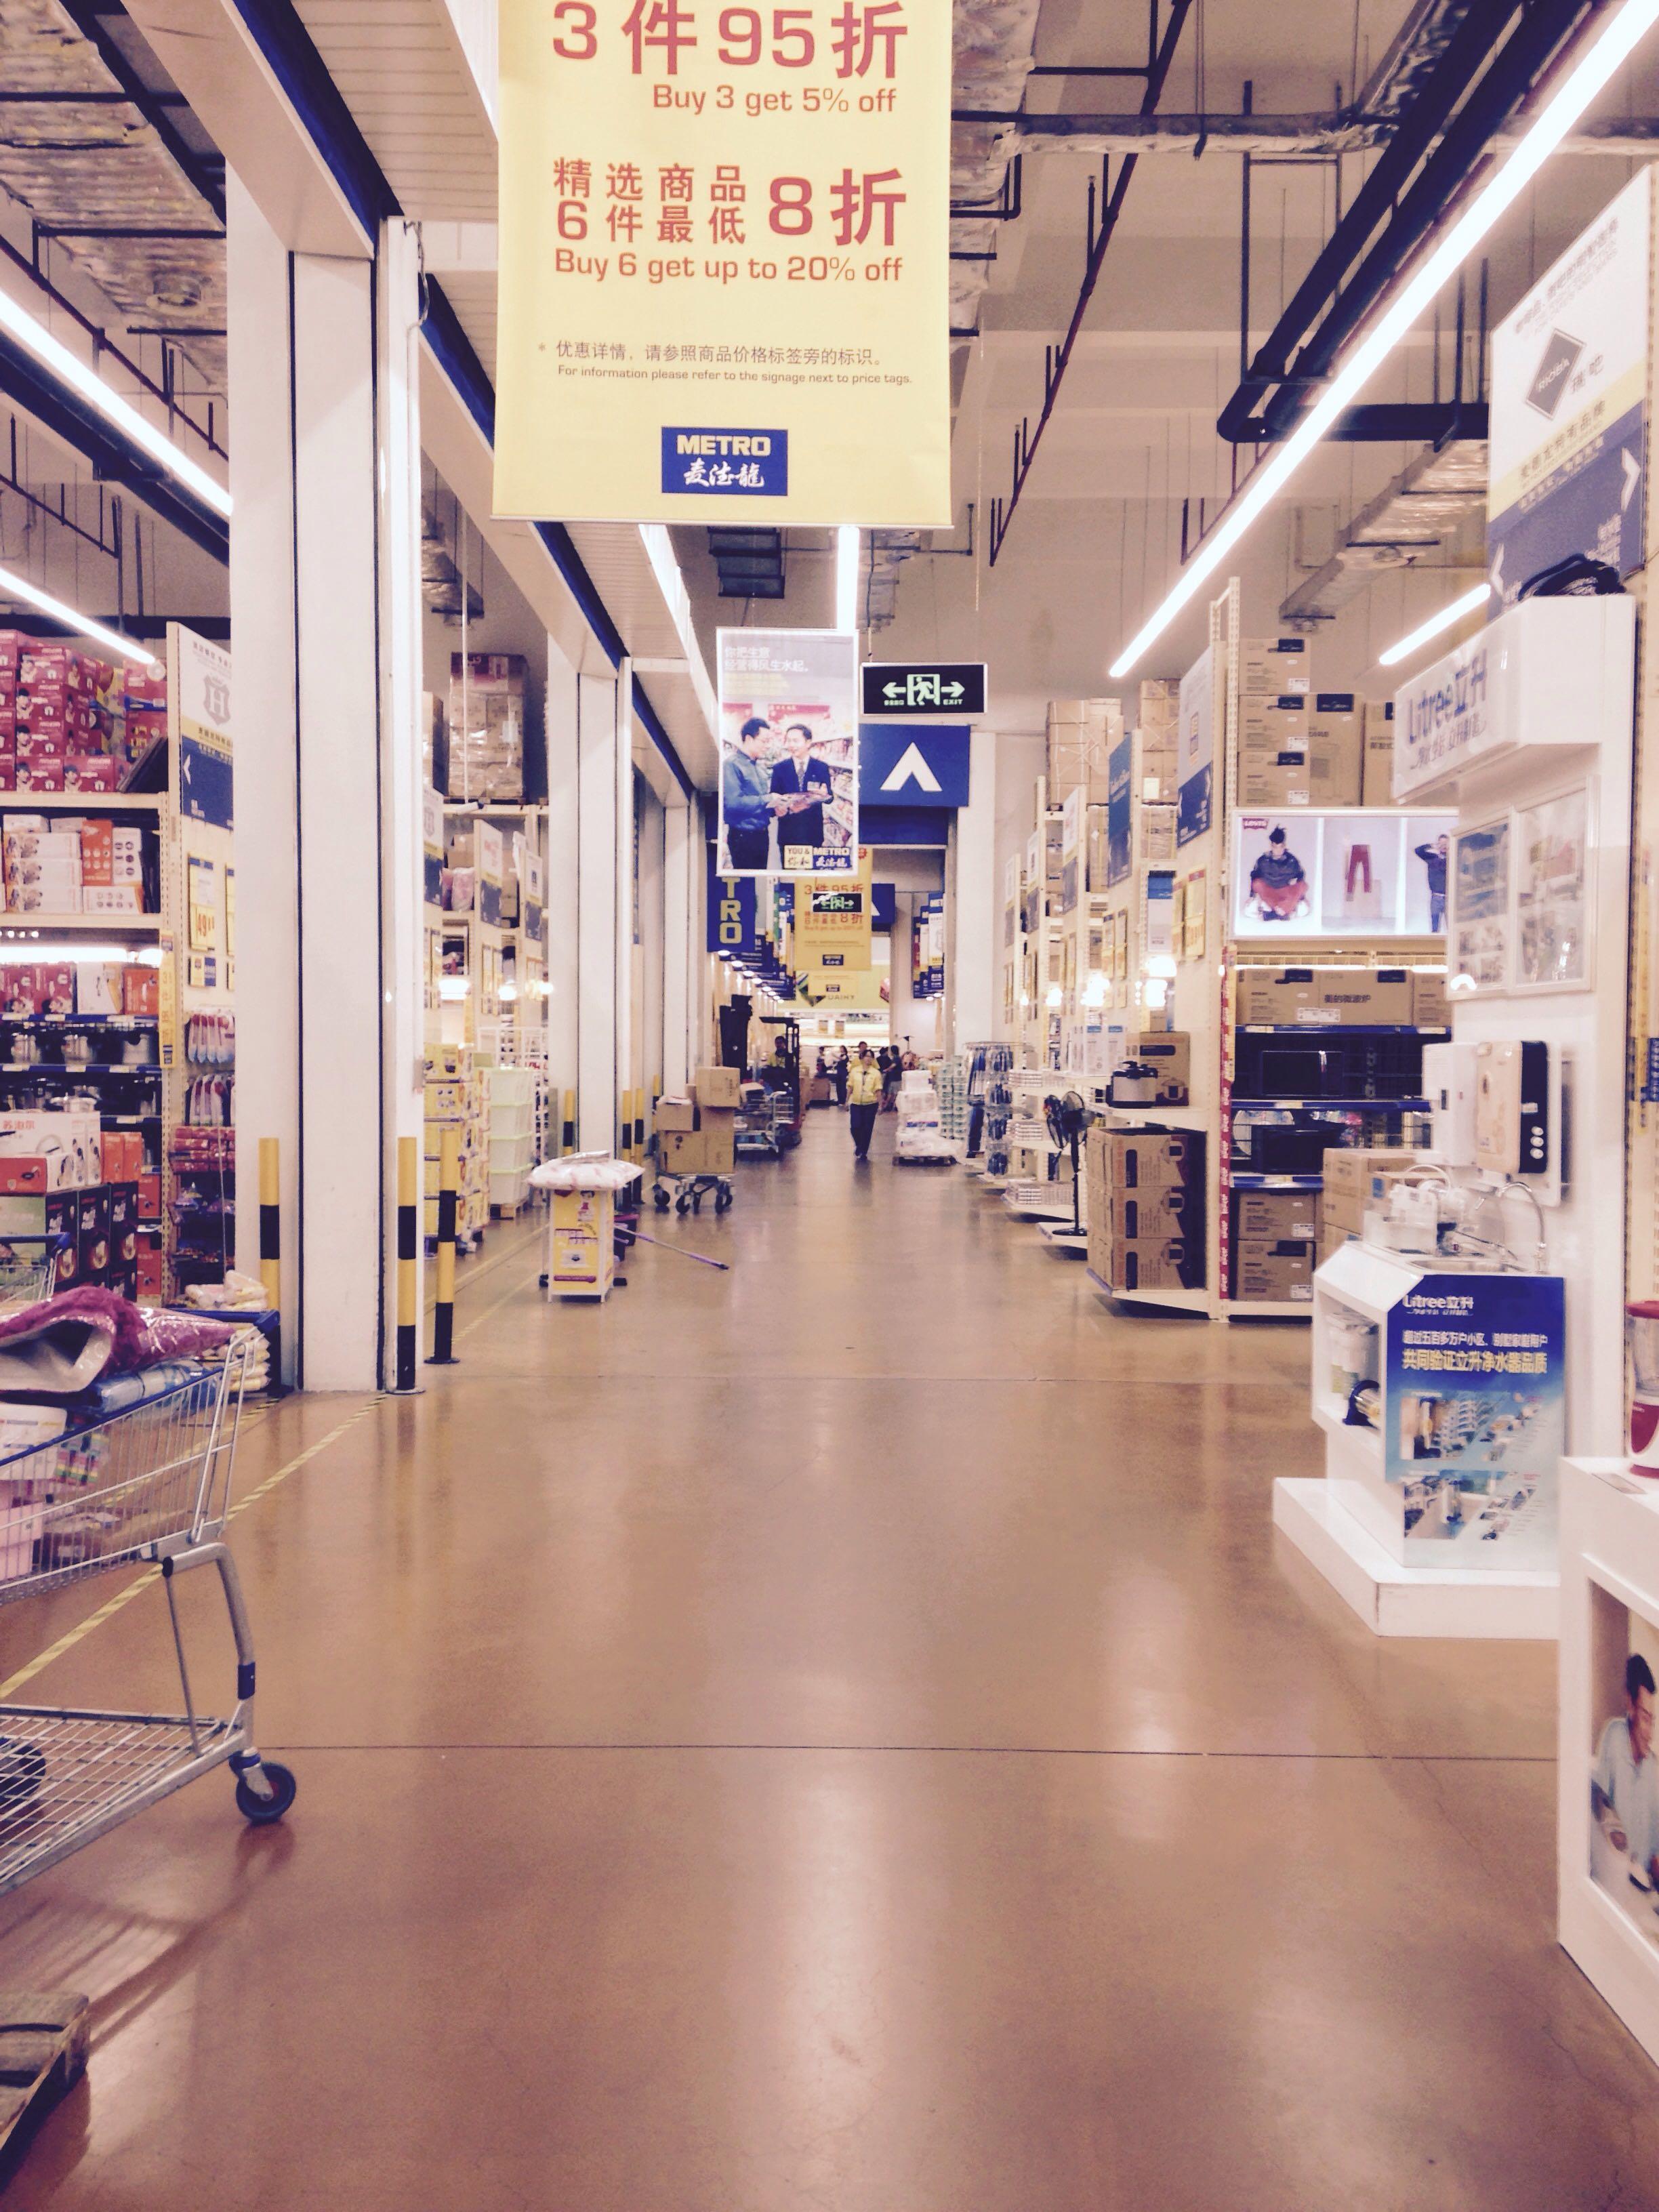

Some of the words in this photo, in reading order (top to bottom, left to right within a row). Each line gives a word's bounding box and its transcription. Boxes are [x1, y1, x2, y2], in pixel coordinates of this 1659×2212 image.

[653, 84, 705, 116] Buy
[716, 85, 734, 109] 3
[745, 89, 792, 117] get
[804, 87, 848, 112] 5%
[859, 89, 896, 112] off
[554, 157, 746, 202] 精选商品
[769, 169, 907, 246] 8折
[555, 248, 608, 282] Buy
[618, 252, 636, 276] 6
[648, 255, 695, 284] get
[705, 260, 738, 285] up
[748, 258, 777, 280] to
[787, 255, 855, 281] 20%
[865, 256, 902, 281] off
[558, 365, 577, 376] For
[581, 366, 648, 380] information
[651, 368, 689, 382] please
[692, 369, 721, 380] refer
[724, 371, 736, 381] to
[739, 370, 758, 382] the
[762, 371, 805, 386] signage
[808, 373, 834, 384] next
[836, 374, 848, 384] to
[852, 373, 880, 386] price
[884, 374, 912, 386] tags.
[677, 434, 771, 457] METRO
[813, 846, 851, 856] METRO
